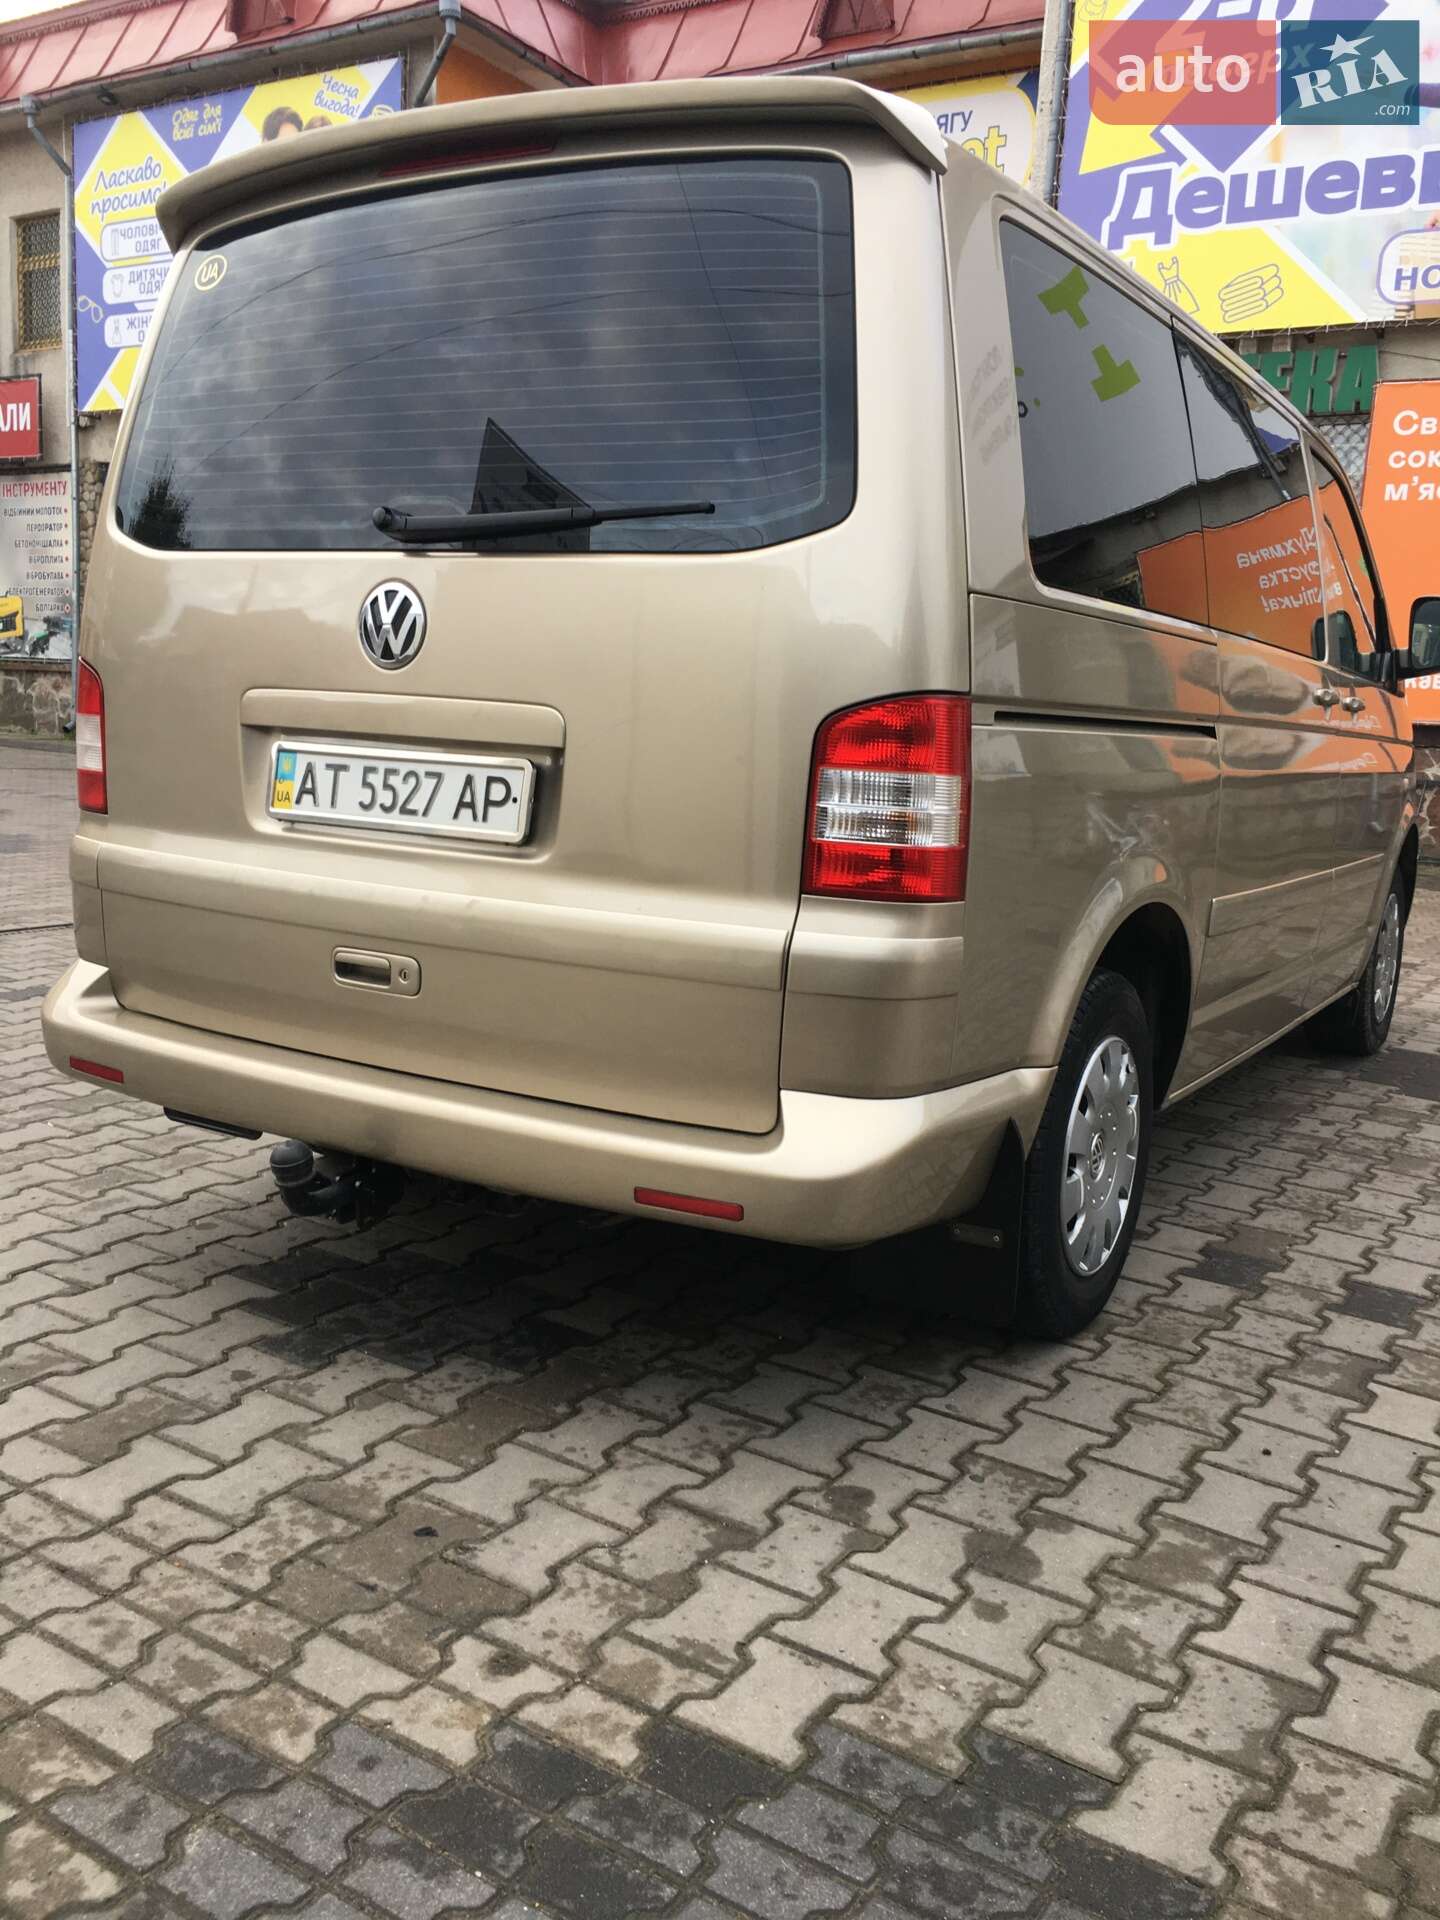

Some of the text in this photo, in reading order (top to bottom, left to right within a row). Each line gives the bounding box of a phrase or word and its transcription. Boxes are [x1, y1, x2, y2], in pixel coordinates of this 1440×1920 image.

[322, 73, 359, 99] Чесна
[314, 90, 361, 118] вигода!
[935, 110, 973, 134] ЯГУ
[94, 155, 162, 192] Ласкаво
[120, 223, 160, 240] ЧОЛОВІ
[135, 238, 162, 253] ОДЯГ
[128, 266, 171, 285] ДИТЯЧИ
[200, 261, 219, 283] UA
[1392, 409, 1440, 436] Св
[1387, 449, 1440, 469] сок
[2, 480, 67, 498] ІНСТРУМЕНТУ
[1384, 475, 1440, 501] м'я
[276, 789, 292, 804] UA
[294, 761, 512, 824] AT 5527 AP
